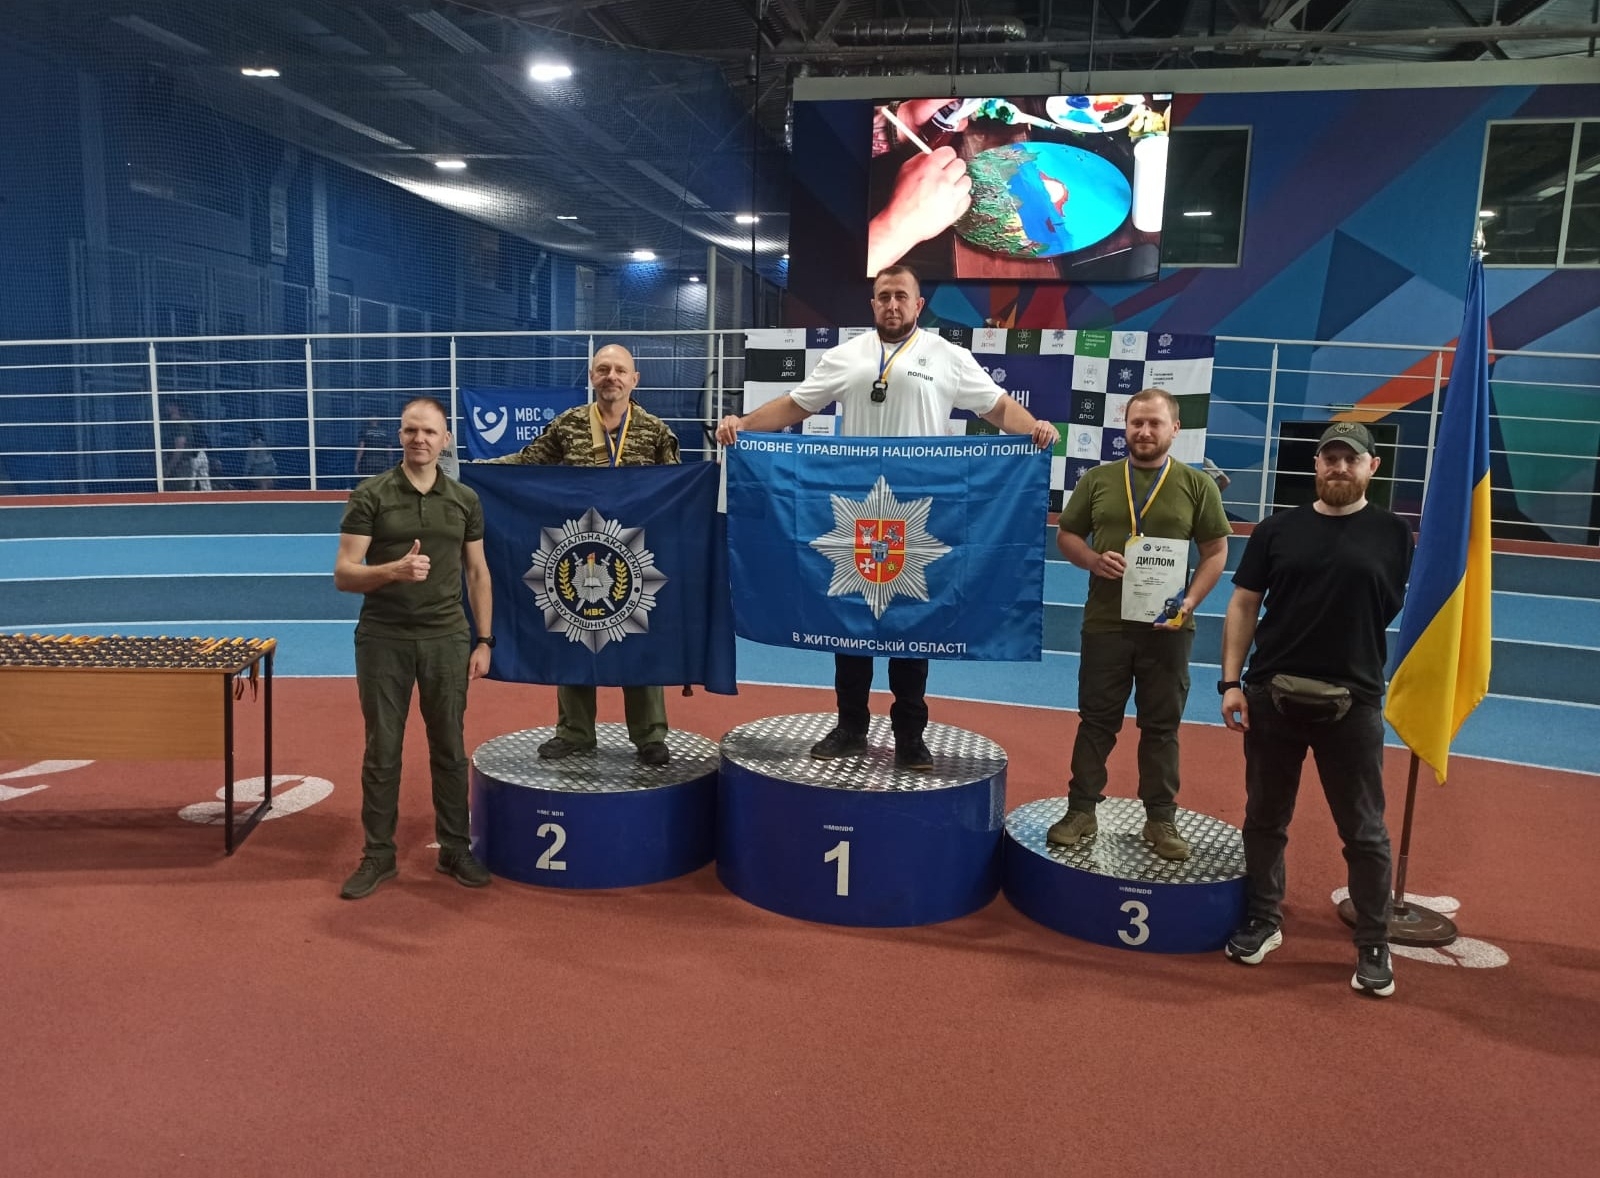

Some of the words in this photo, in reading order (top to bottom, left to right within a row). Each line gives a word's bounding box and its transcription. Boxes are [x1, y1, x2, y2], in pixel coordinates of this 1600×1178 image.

[514, 407, 542, 423] МВС
[734, 439, 793, 454] ГОЛОВНЕ
[796, 443, 879, 457] УПРАВЛІННЯ
[882, 443, 988, 459] НАЦІОНАЛЬНОЇ
[546, 533, 601, 580] НАЦІОНАЛЬНА
[603, 536, 641, 579] АКАДЕМІЯ
[1135, 556, 1175, 568] ДИПЛОМ
[553, 599, 608, 629] ВНУТРІШНІХ
[609, 600, 636, 625] СПРАВ
[583, 608, 606, 616] МВС
[792, 631, 801, 642] В
[803, 633, 905, 652] ЖИТОМИРСЬКІЙ
[908, 641, 967, 654] ОБЛАСТІ
[536, 823, 567, 871] 2
[824, 840, 850, 896] 1
[1124, 886, 1153, 895] MONDO
[1117, 900, 1150, 946] 3
